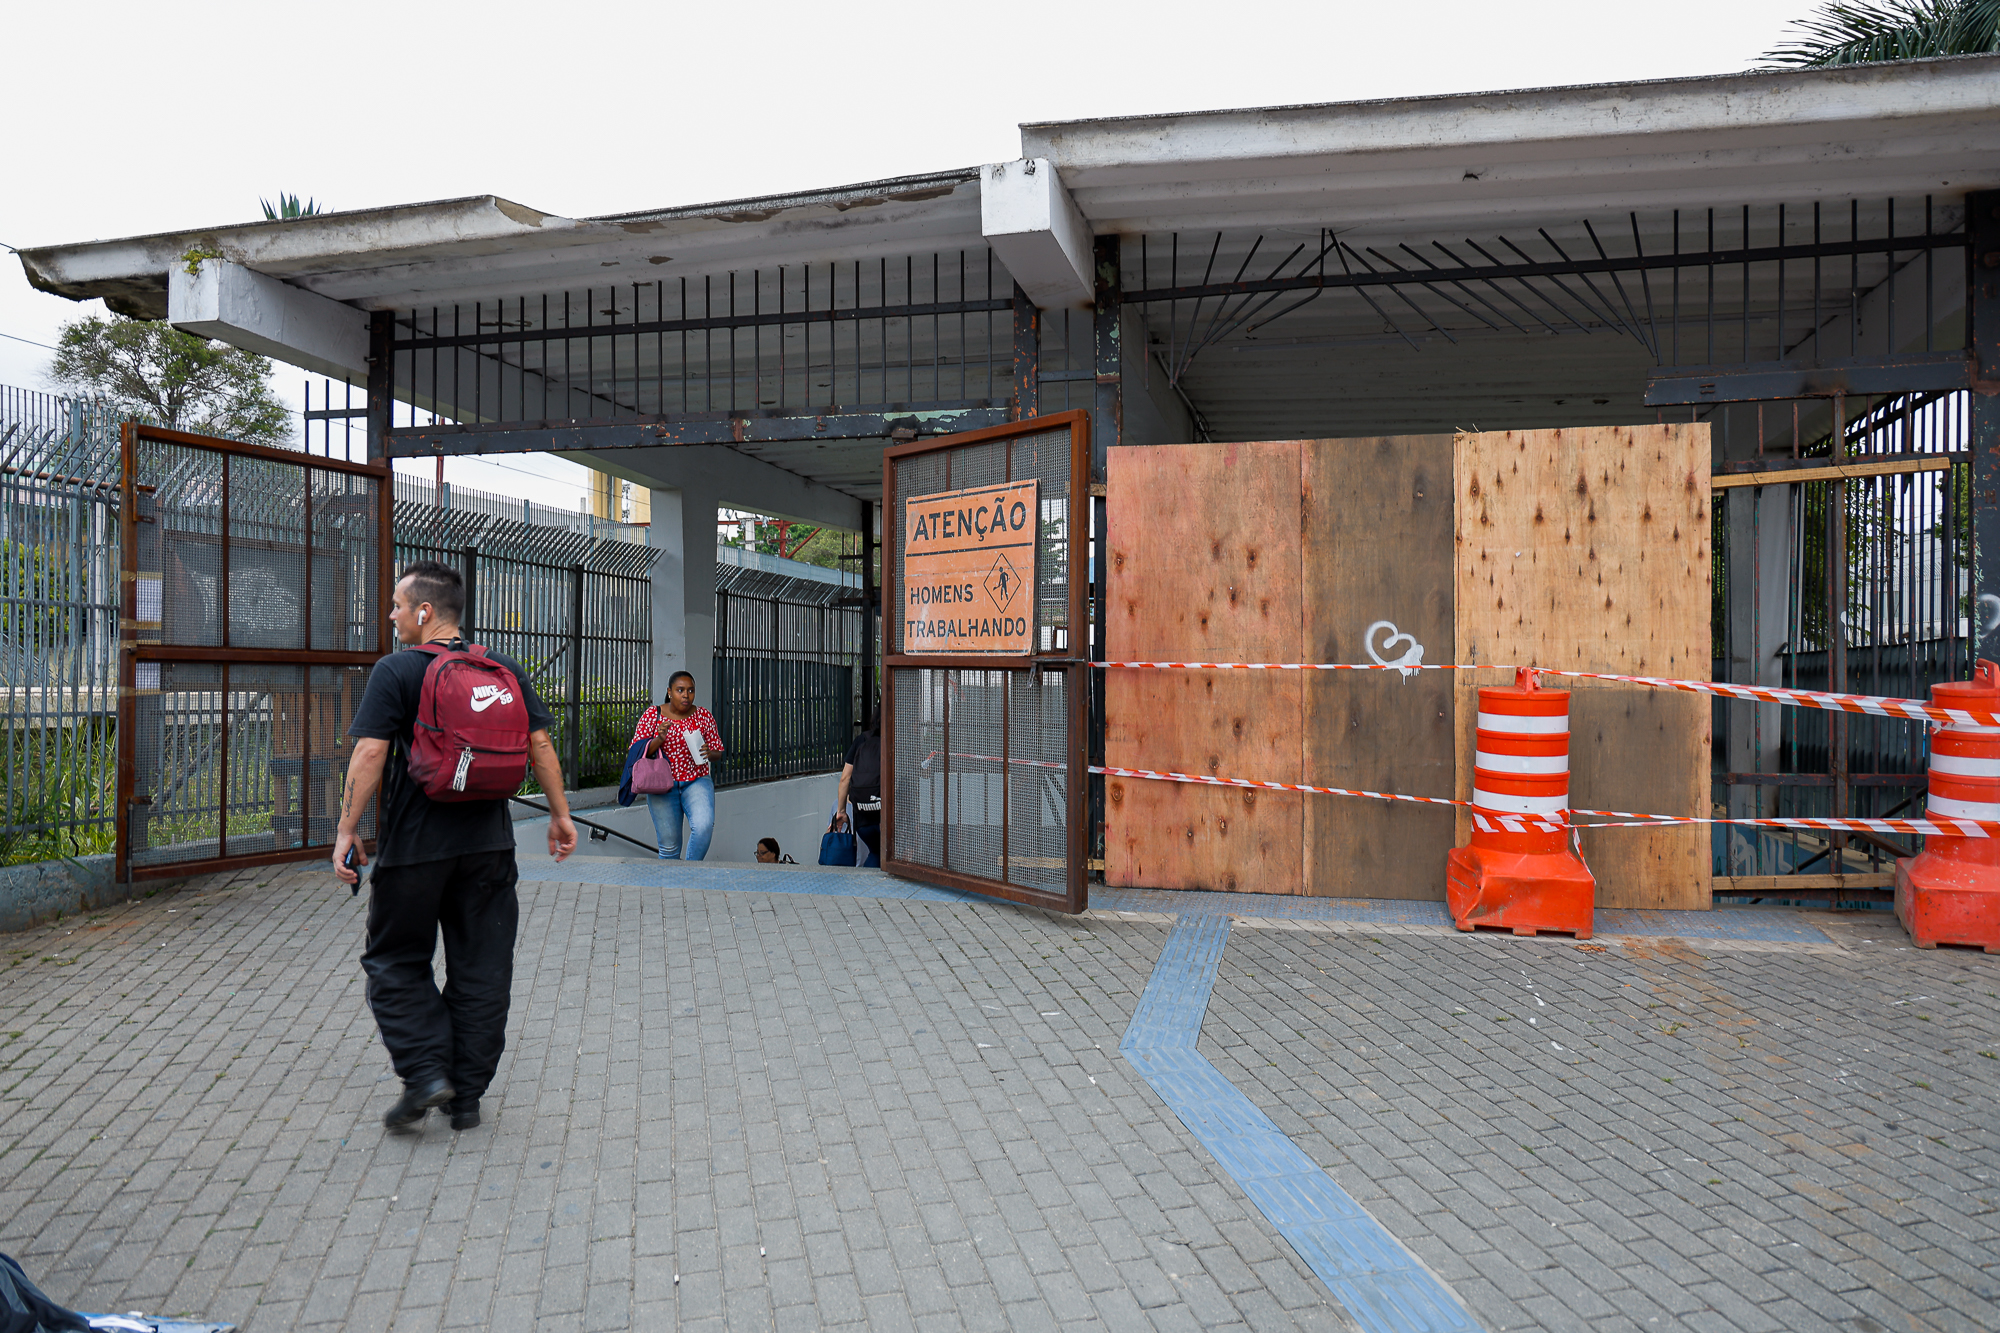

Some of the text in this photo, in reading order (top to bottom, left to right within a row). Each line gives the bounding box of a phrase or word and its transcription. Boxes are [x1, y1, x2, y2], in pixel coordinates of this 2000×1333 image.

[913, 496, 1026, 542] ATENÇÃO
[910, 583, 974, 605] HOMENS
[907, 616, 1026, 638] TRABALHANDO
[472, 684, 514, 705] NIKE SB
